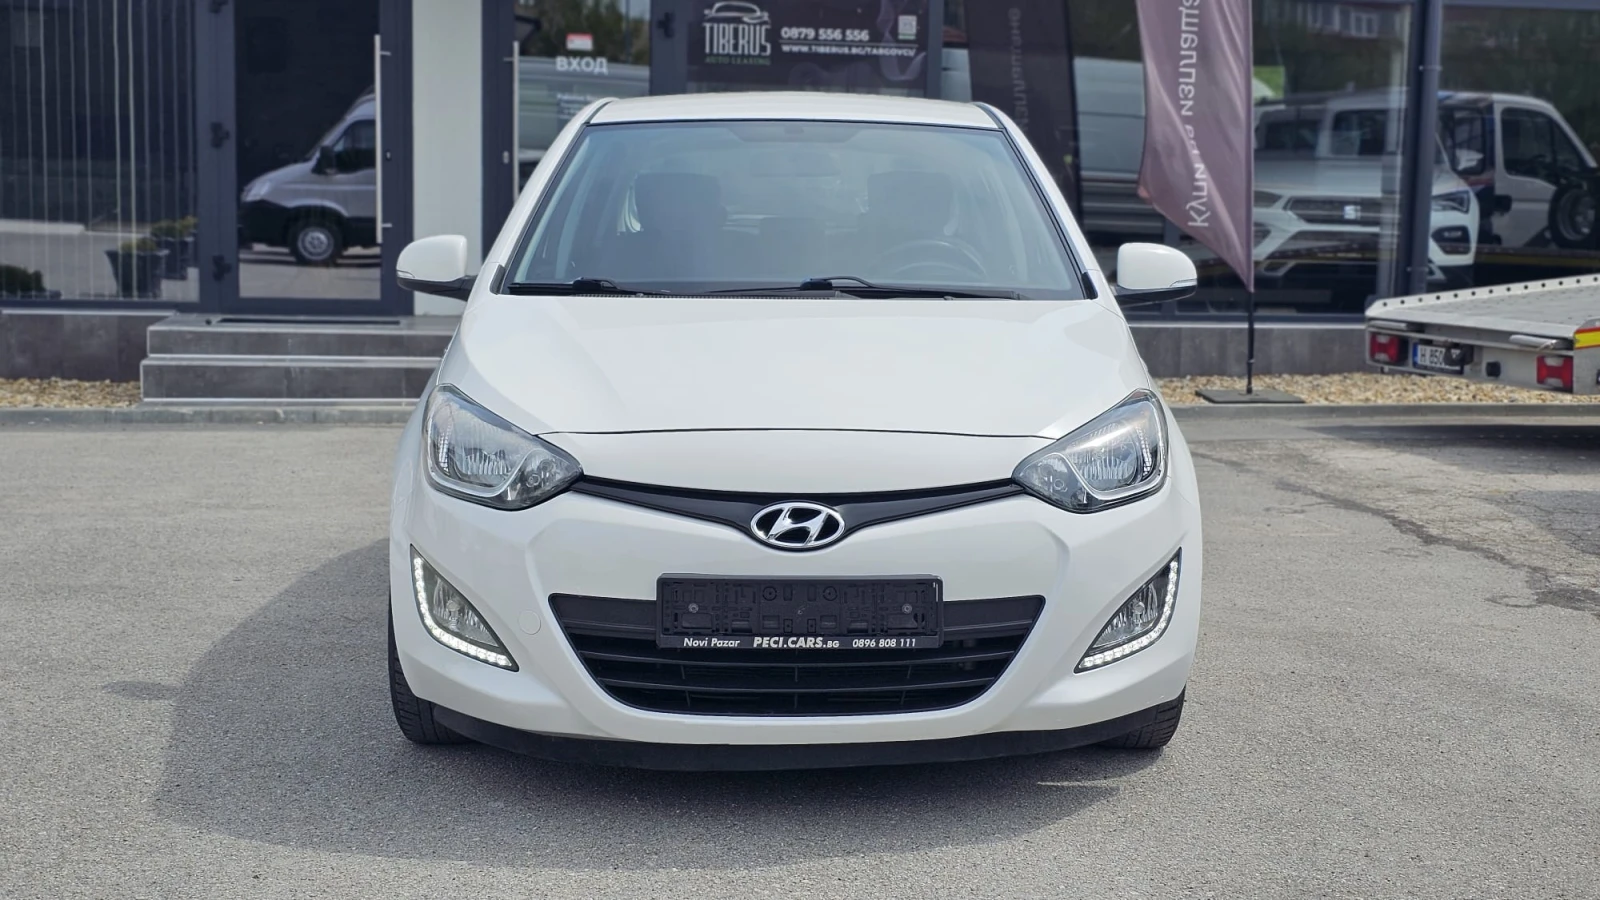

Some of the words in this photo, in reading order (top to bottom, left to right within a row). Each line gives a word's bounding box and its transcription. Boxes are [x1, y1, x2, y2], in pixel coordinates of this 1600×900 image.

[703, 22, 771, 56] TIBERUS
[781, 27, 815, 40] 0879
[818, 28, 843, 41] 556
[845, 29, 870, 42] 556
[556, 56, 608, 75] ВХОД
[683, 637, 708, 647] Novi
[711, 637, 740, 648] Pazar
[753, 636, 840, 648] PECI.CARS.BG
[852, 638, 876, 648] 0896
[879, 638, 898, 648] 808
[899, 638, 917, 648] 111
